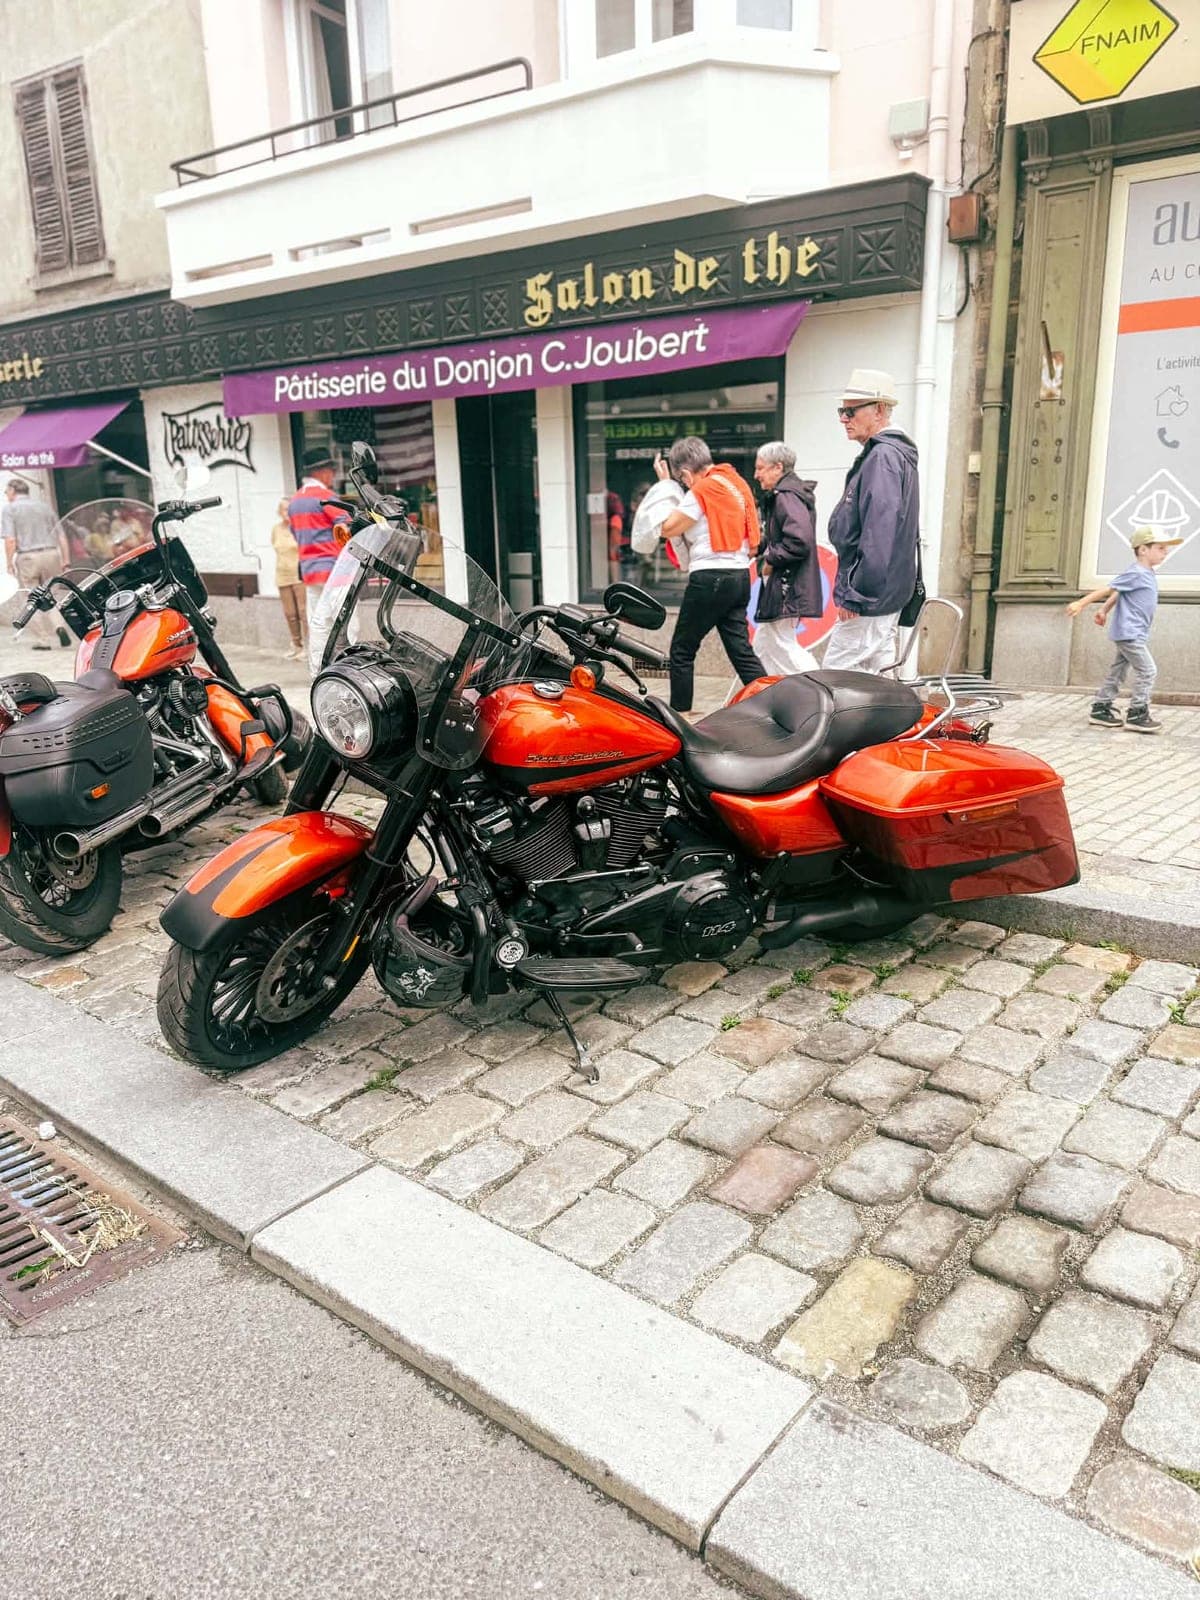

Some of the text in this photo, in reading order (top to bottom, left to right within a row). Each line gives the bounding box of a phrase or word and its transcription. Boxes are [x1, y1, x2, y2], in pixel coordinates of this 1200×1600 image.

[1081, 20, 1160, 55] FNAIM
[524, 262, 655, 328] Salon
[671, 248, 720, 294] de
[1150, 265, 1175, 283] AU
[274, 323, 709, 402] Pâtisserie du Donjon C.Joubert
[2, 453, 25, 467] Salon
[27, 452, 39, 466] de
